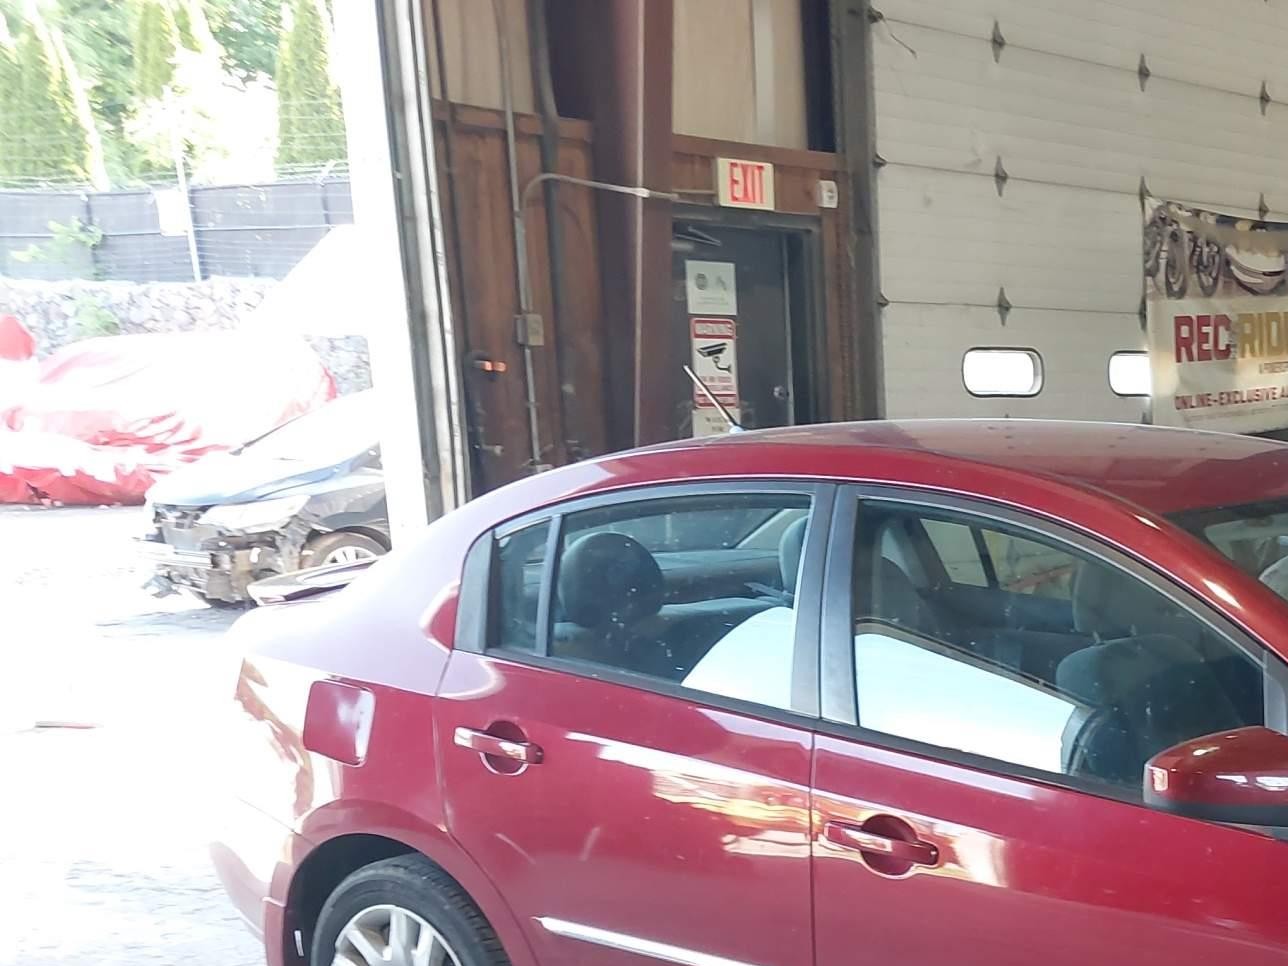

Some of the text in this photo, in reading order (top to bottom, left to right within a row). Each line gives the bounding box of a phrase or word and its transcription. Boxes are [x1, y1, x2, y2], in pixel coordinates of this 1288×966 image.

[729, 162, 764, 204] EXIT
[1174, 314, 1233, 362] REC
[1175, 386, 1277, 410] ONLINE-EXCLUSIVE
